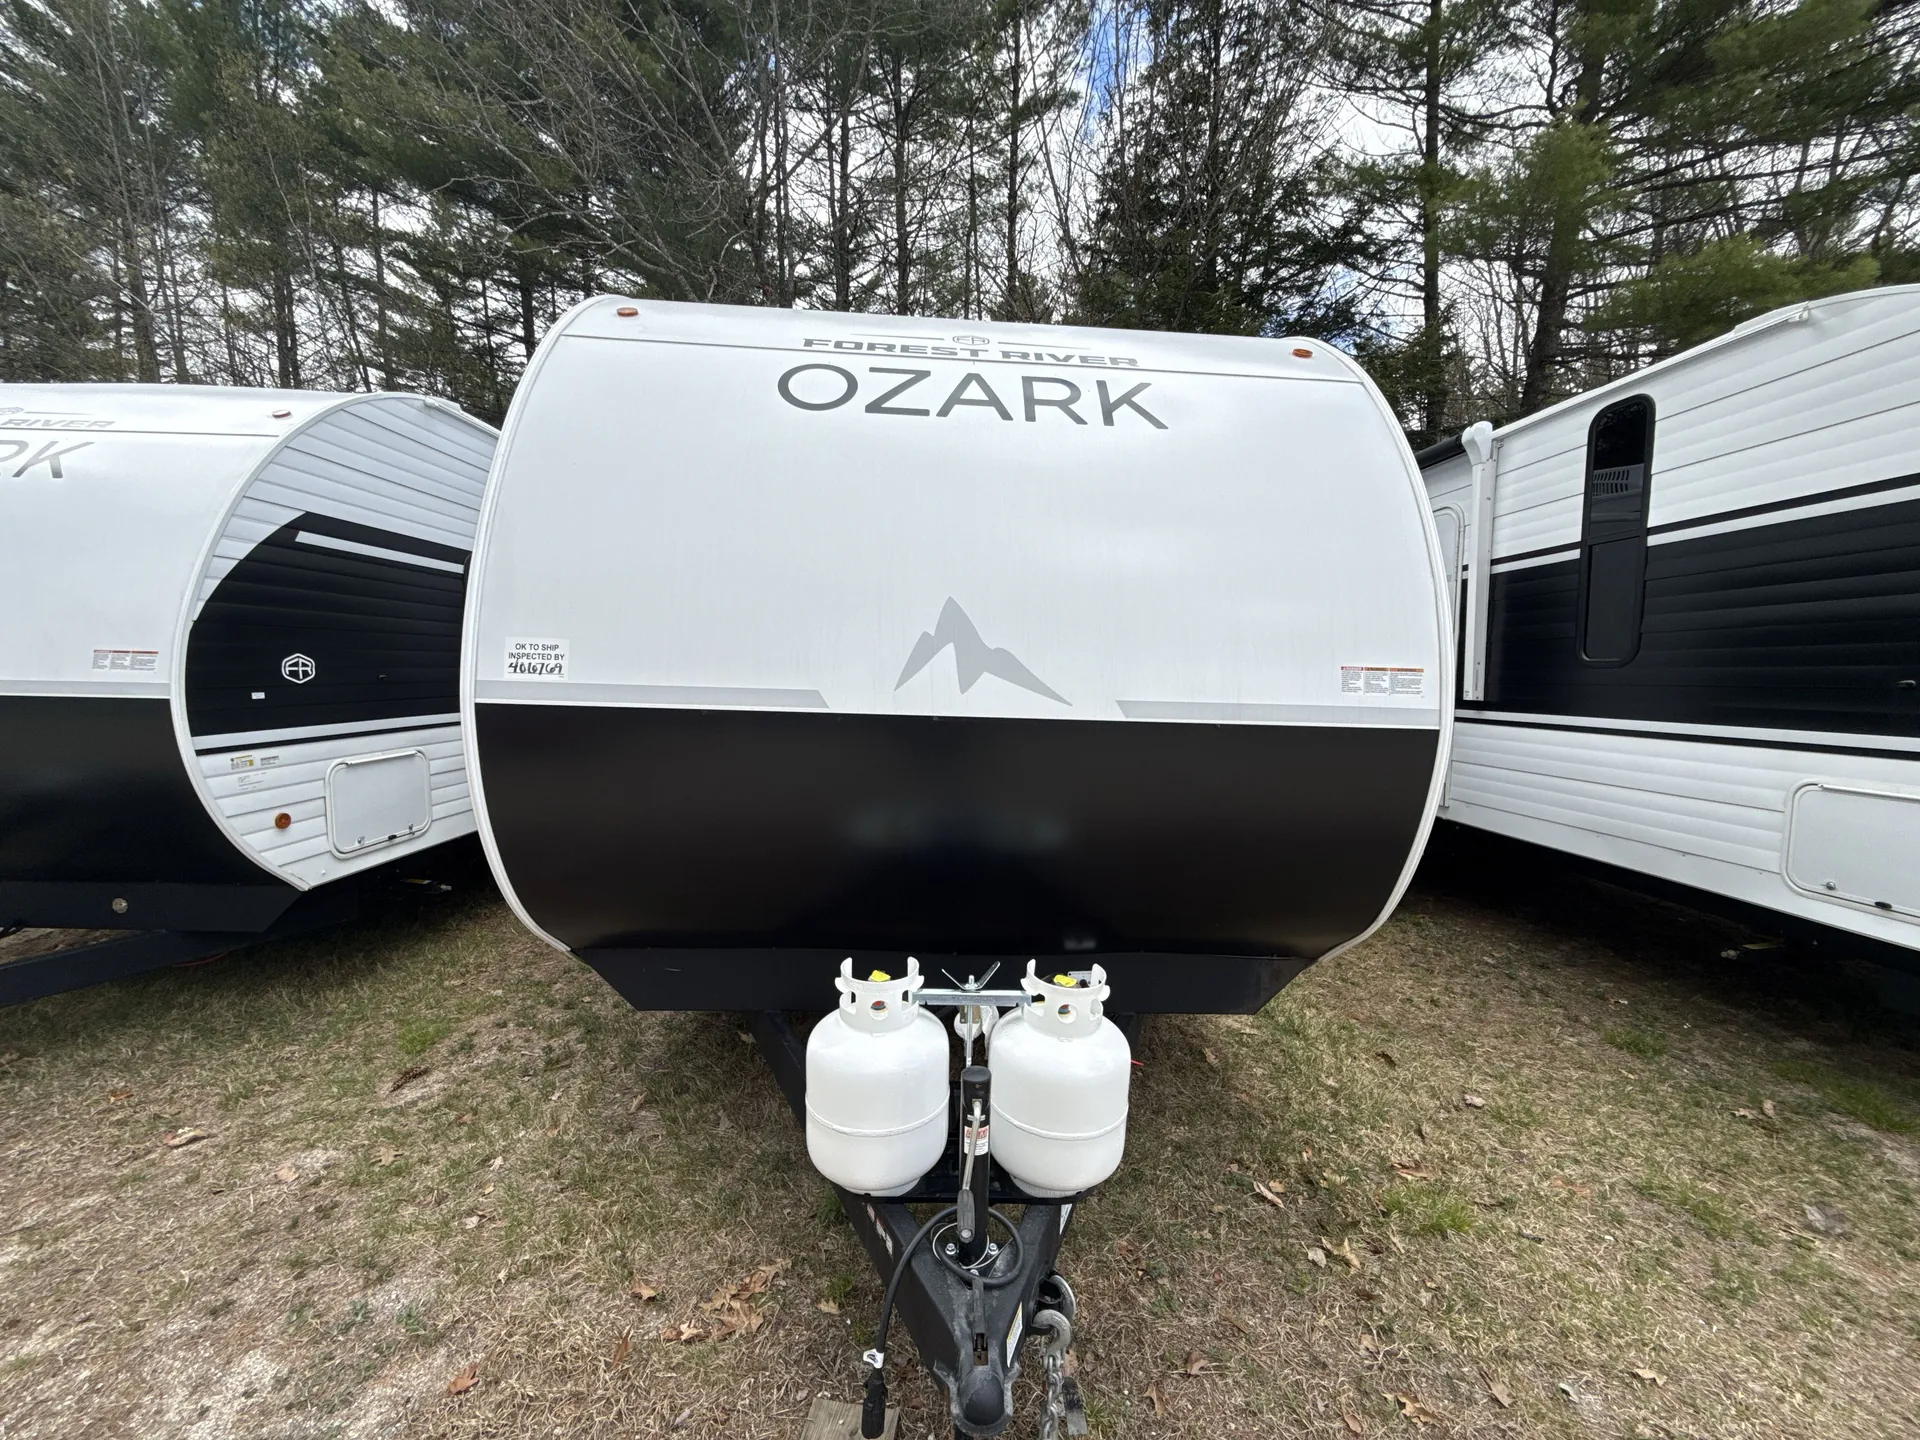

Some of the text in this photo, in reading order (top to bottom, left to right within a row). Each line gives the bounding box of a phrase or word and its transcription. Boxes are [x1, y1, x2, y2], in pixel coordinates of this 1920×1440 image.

[803, 338, 1141, 367] FOREST RIVER
[777, 363, 1169, 429] OZARK
[0, 418, 116, 428] RIVER
[515, 643, 560, 652] OK TO SHIP
[508, 652, 565, 661] INSPECTED BY
